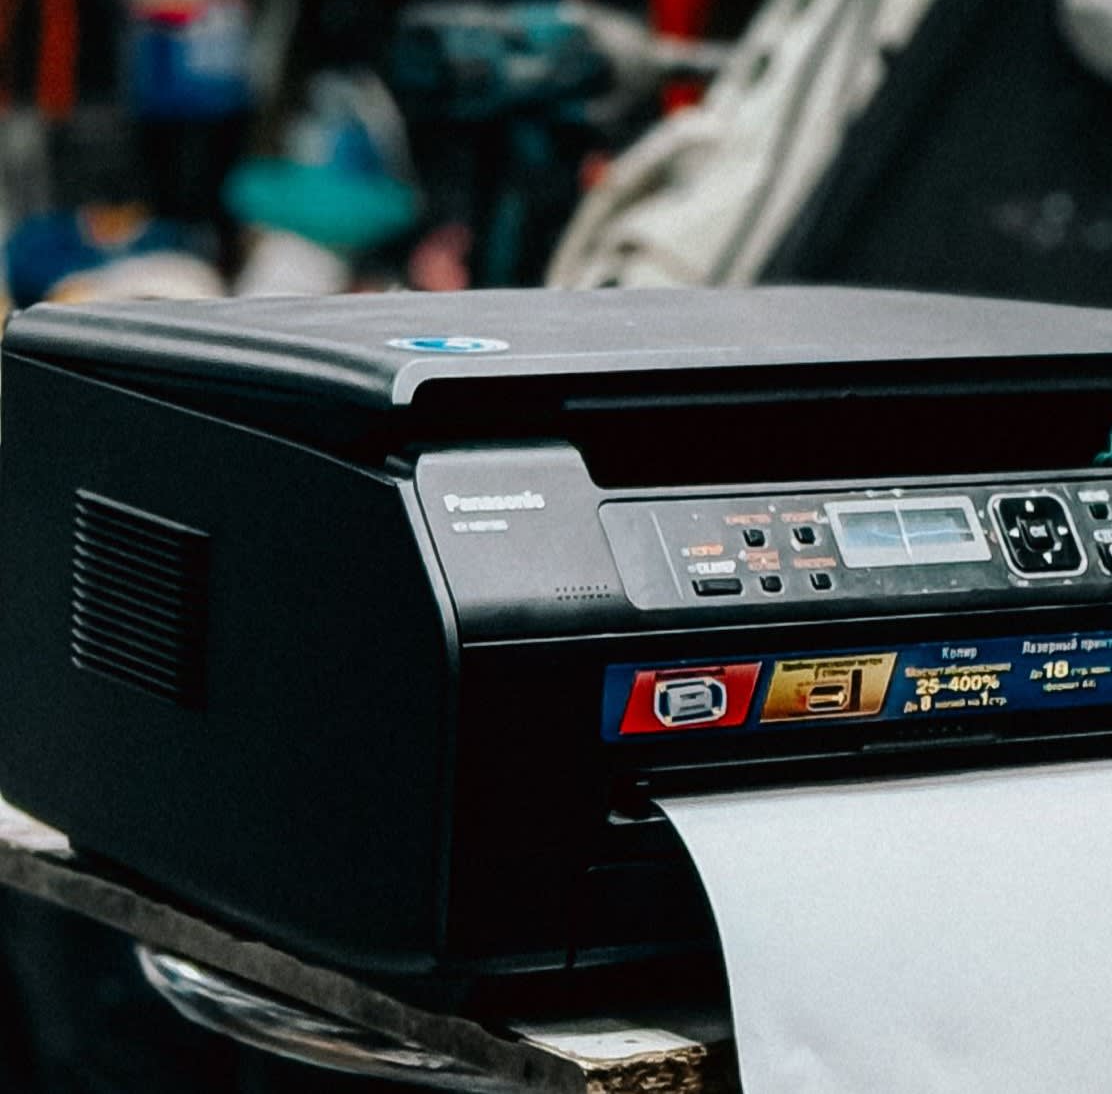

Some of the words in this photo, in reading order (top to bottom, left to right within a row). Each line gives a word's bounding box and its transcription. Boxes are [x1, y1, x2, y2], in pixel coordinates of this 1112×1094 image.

[443, 490, 545, 513] Panasonic
[942, 646, 978, 660] Копир
[1021, 637, 1078, 655] Лазерный
[1043, 660, 1069, 679] 18
[916, 673, 1001, 696] 25-400%
